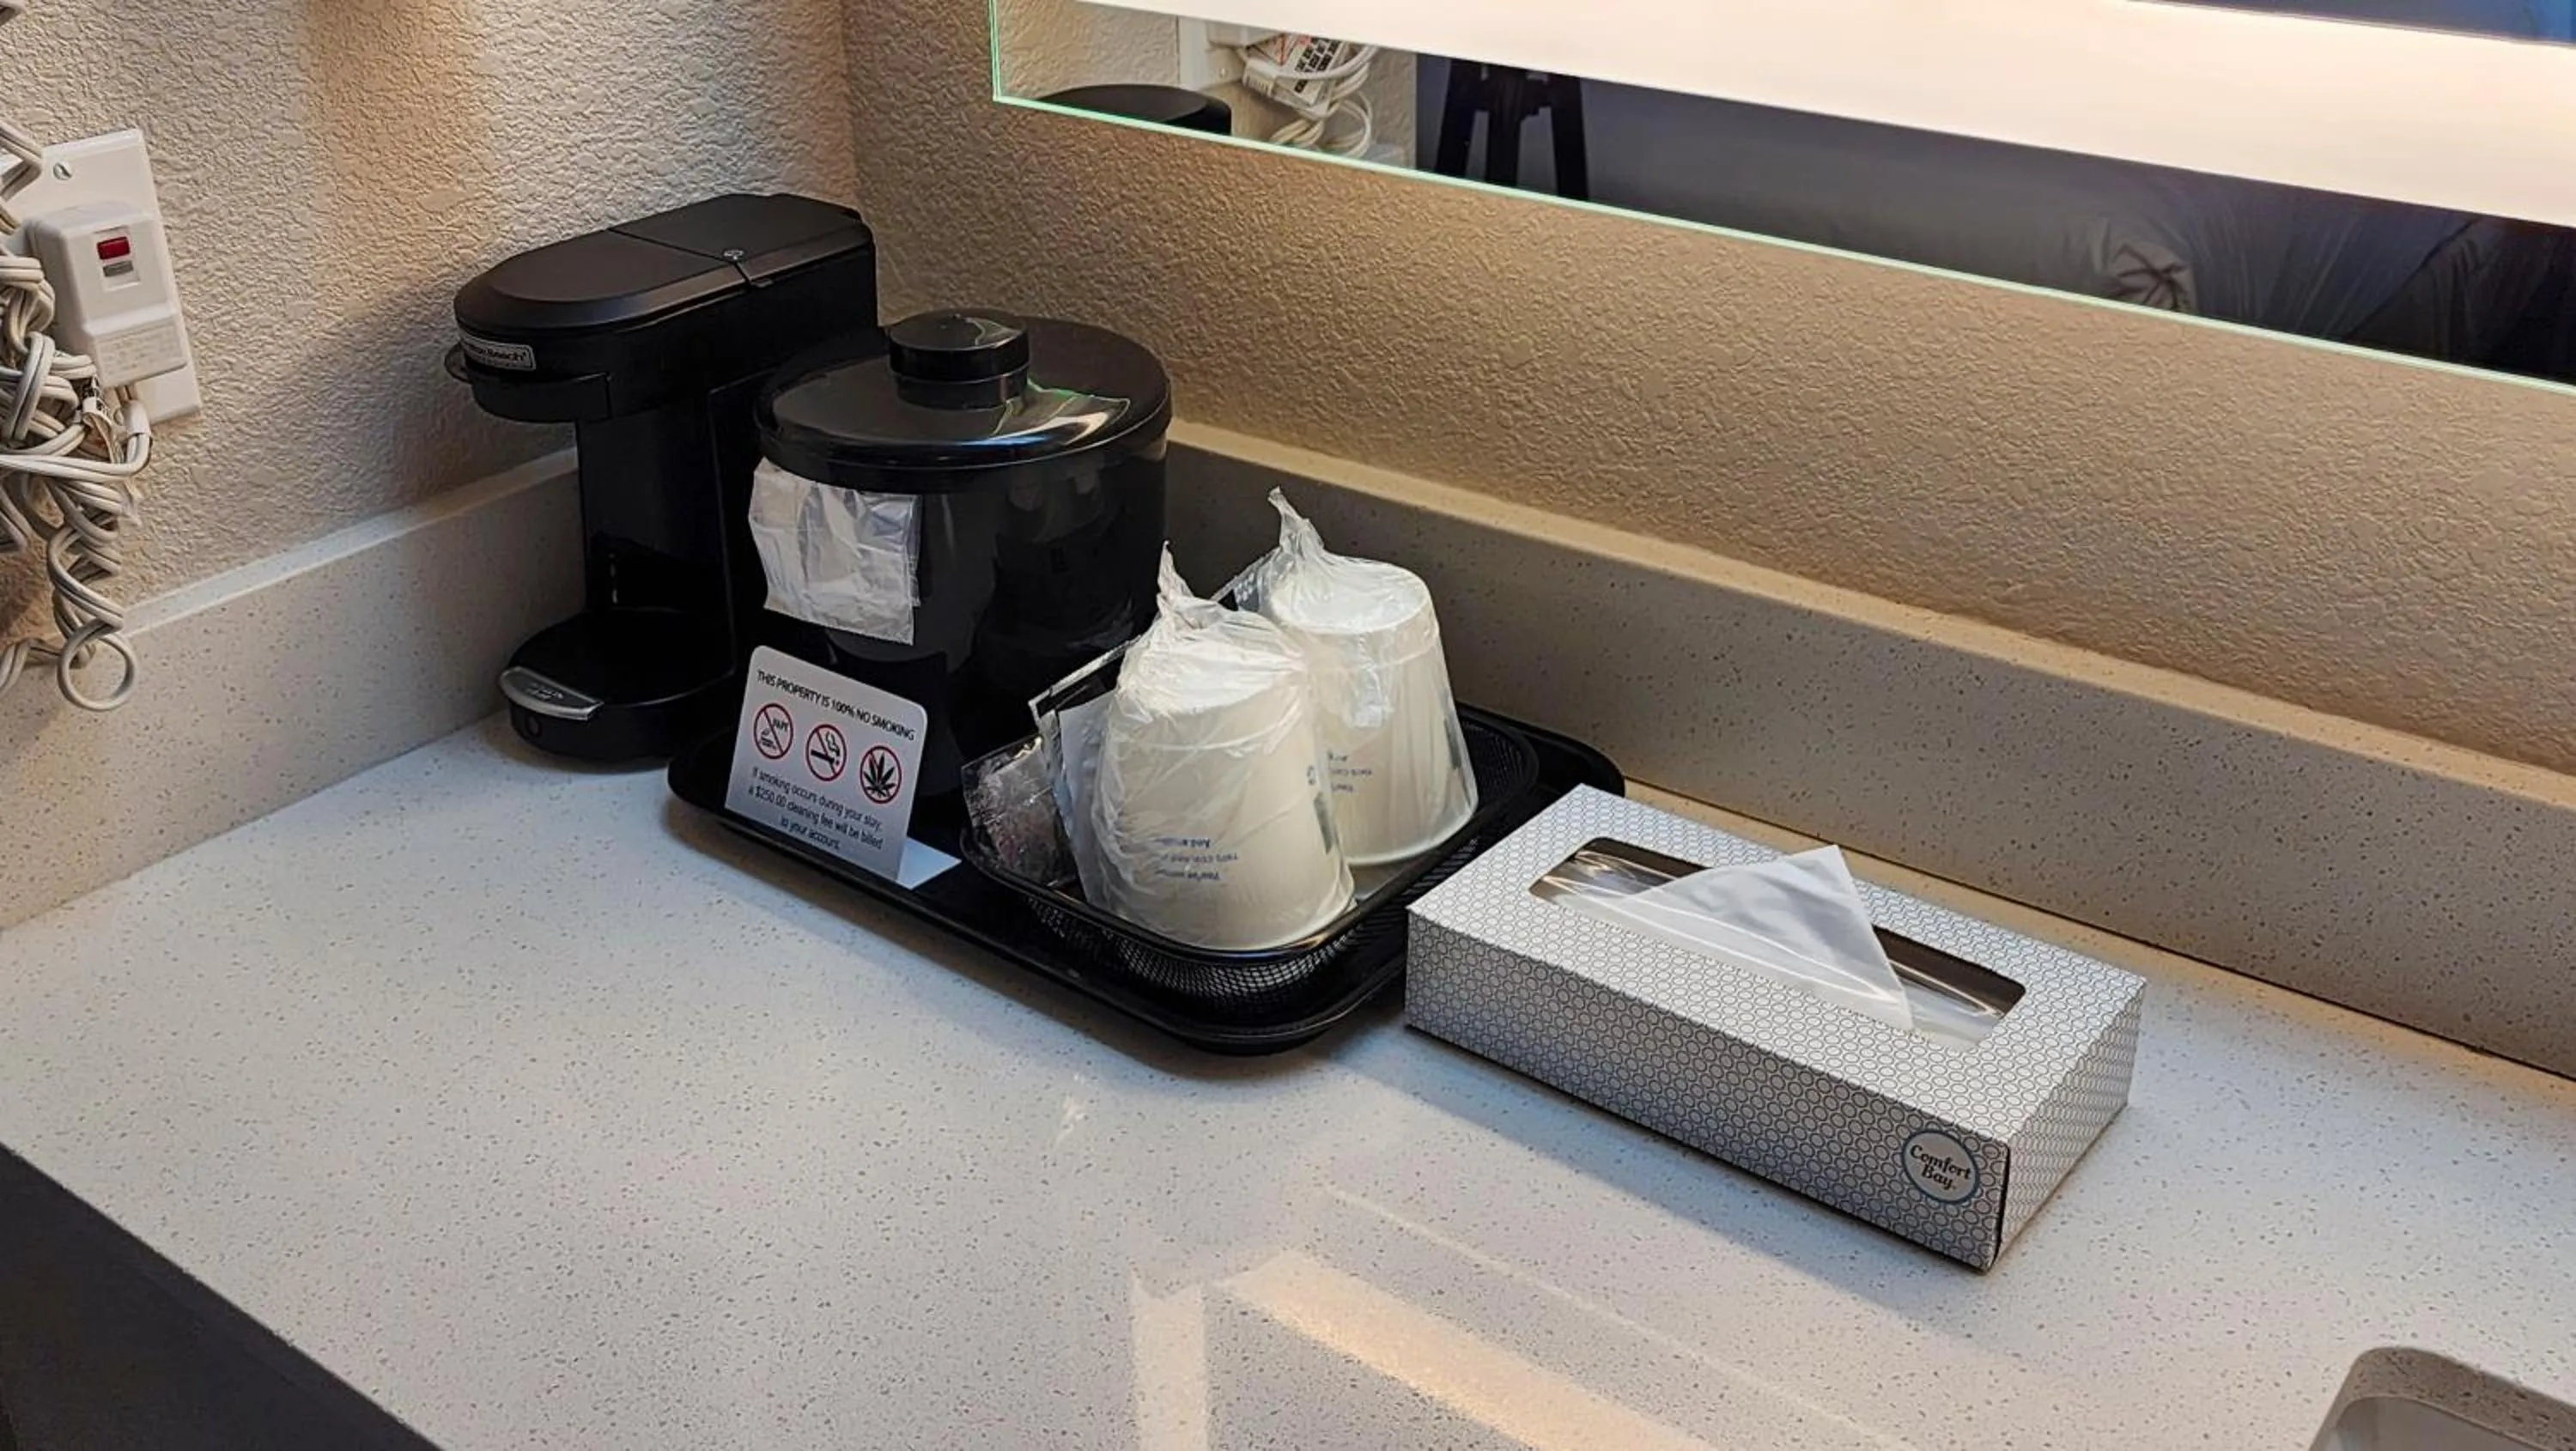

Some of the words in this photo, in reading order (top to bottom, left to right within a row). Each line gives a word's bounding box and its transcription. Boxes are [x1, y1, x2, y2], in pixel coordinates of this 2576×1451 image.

[756, 669, 776, 687] THIS
[775, 677, 822, 704] PROPERTY
[821, 695, 831, 708] IS
[831, 699, 855, 719] 100%
[856, 707, 872, 723] NO
[872, 713, 915, 741] SMOKING
[759, 770, 790, 794] smoking
[791, 784, 817, 804] occurs
[818, 795, 844, 817] during
[844, 807, 864, 822] your
[787, 800, 820, 825] cleaning
[820, 811, 835, 829] fee
[835, 821, 848, 835] will
[848, 826, 860, 840] be
[860, 829, 884, 850] billed
[789, 822, 808, 835] your
[1910, 1144, 1971, 1180] Comfort
